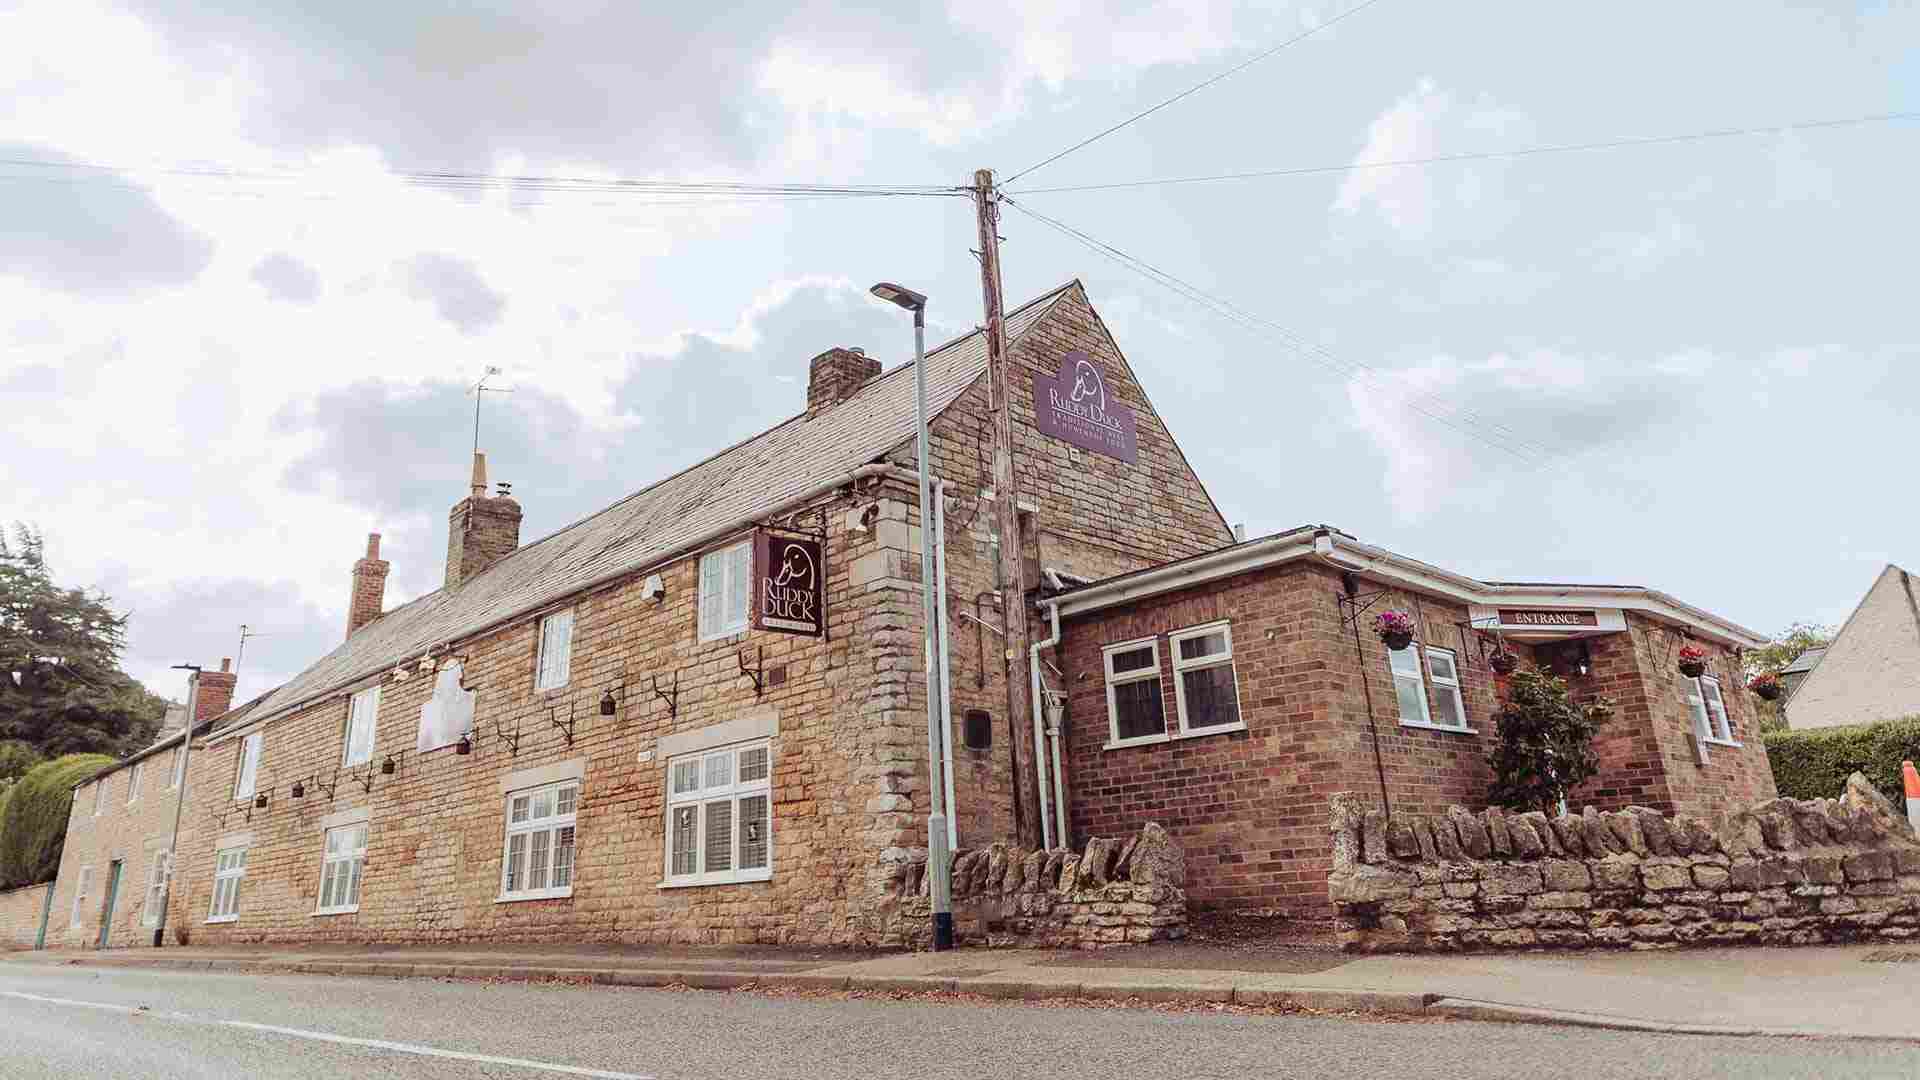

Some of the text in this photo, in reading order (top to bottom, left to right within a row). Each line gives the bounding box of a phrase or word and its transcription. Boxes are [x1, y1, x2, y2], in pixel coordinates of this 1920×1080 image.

[762, 576, 815, 606] RUDDY
[762, 598, 816, 621] DUCK
[1514, 612, 1580, 625] ENTRANCE
